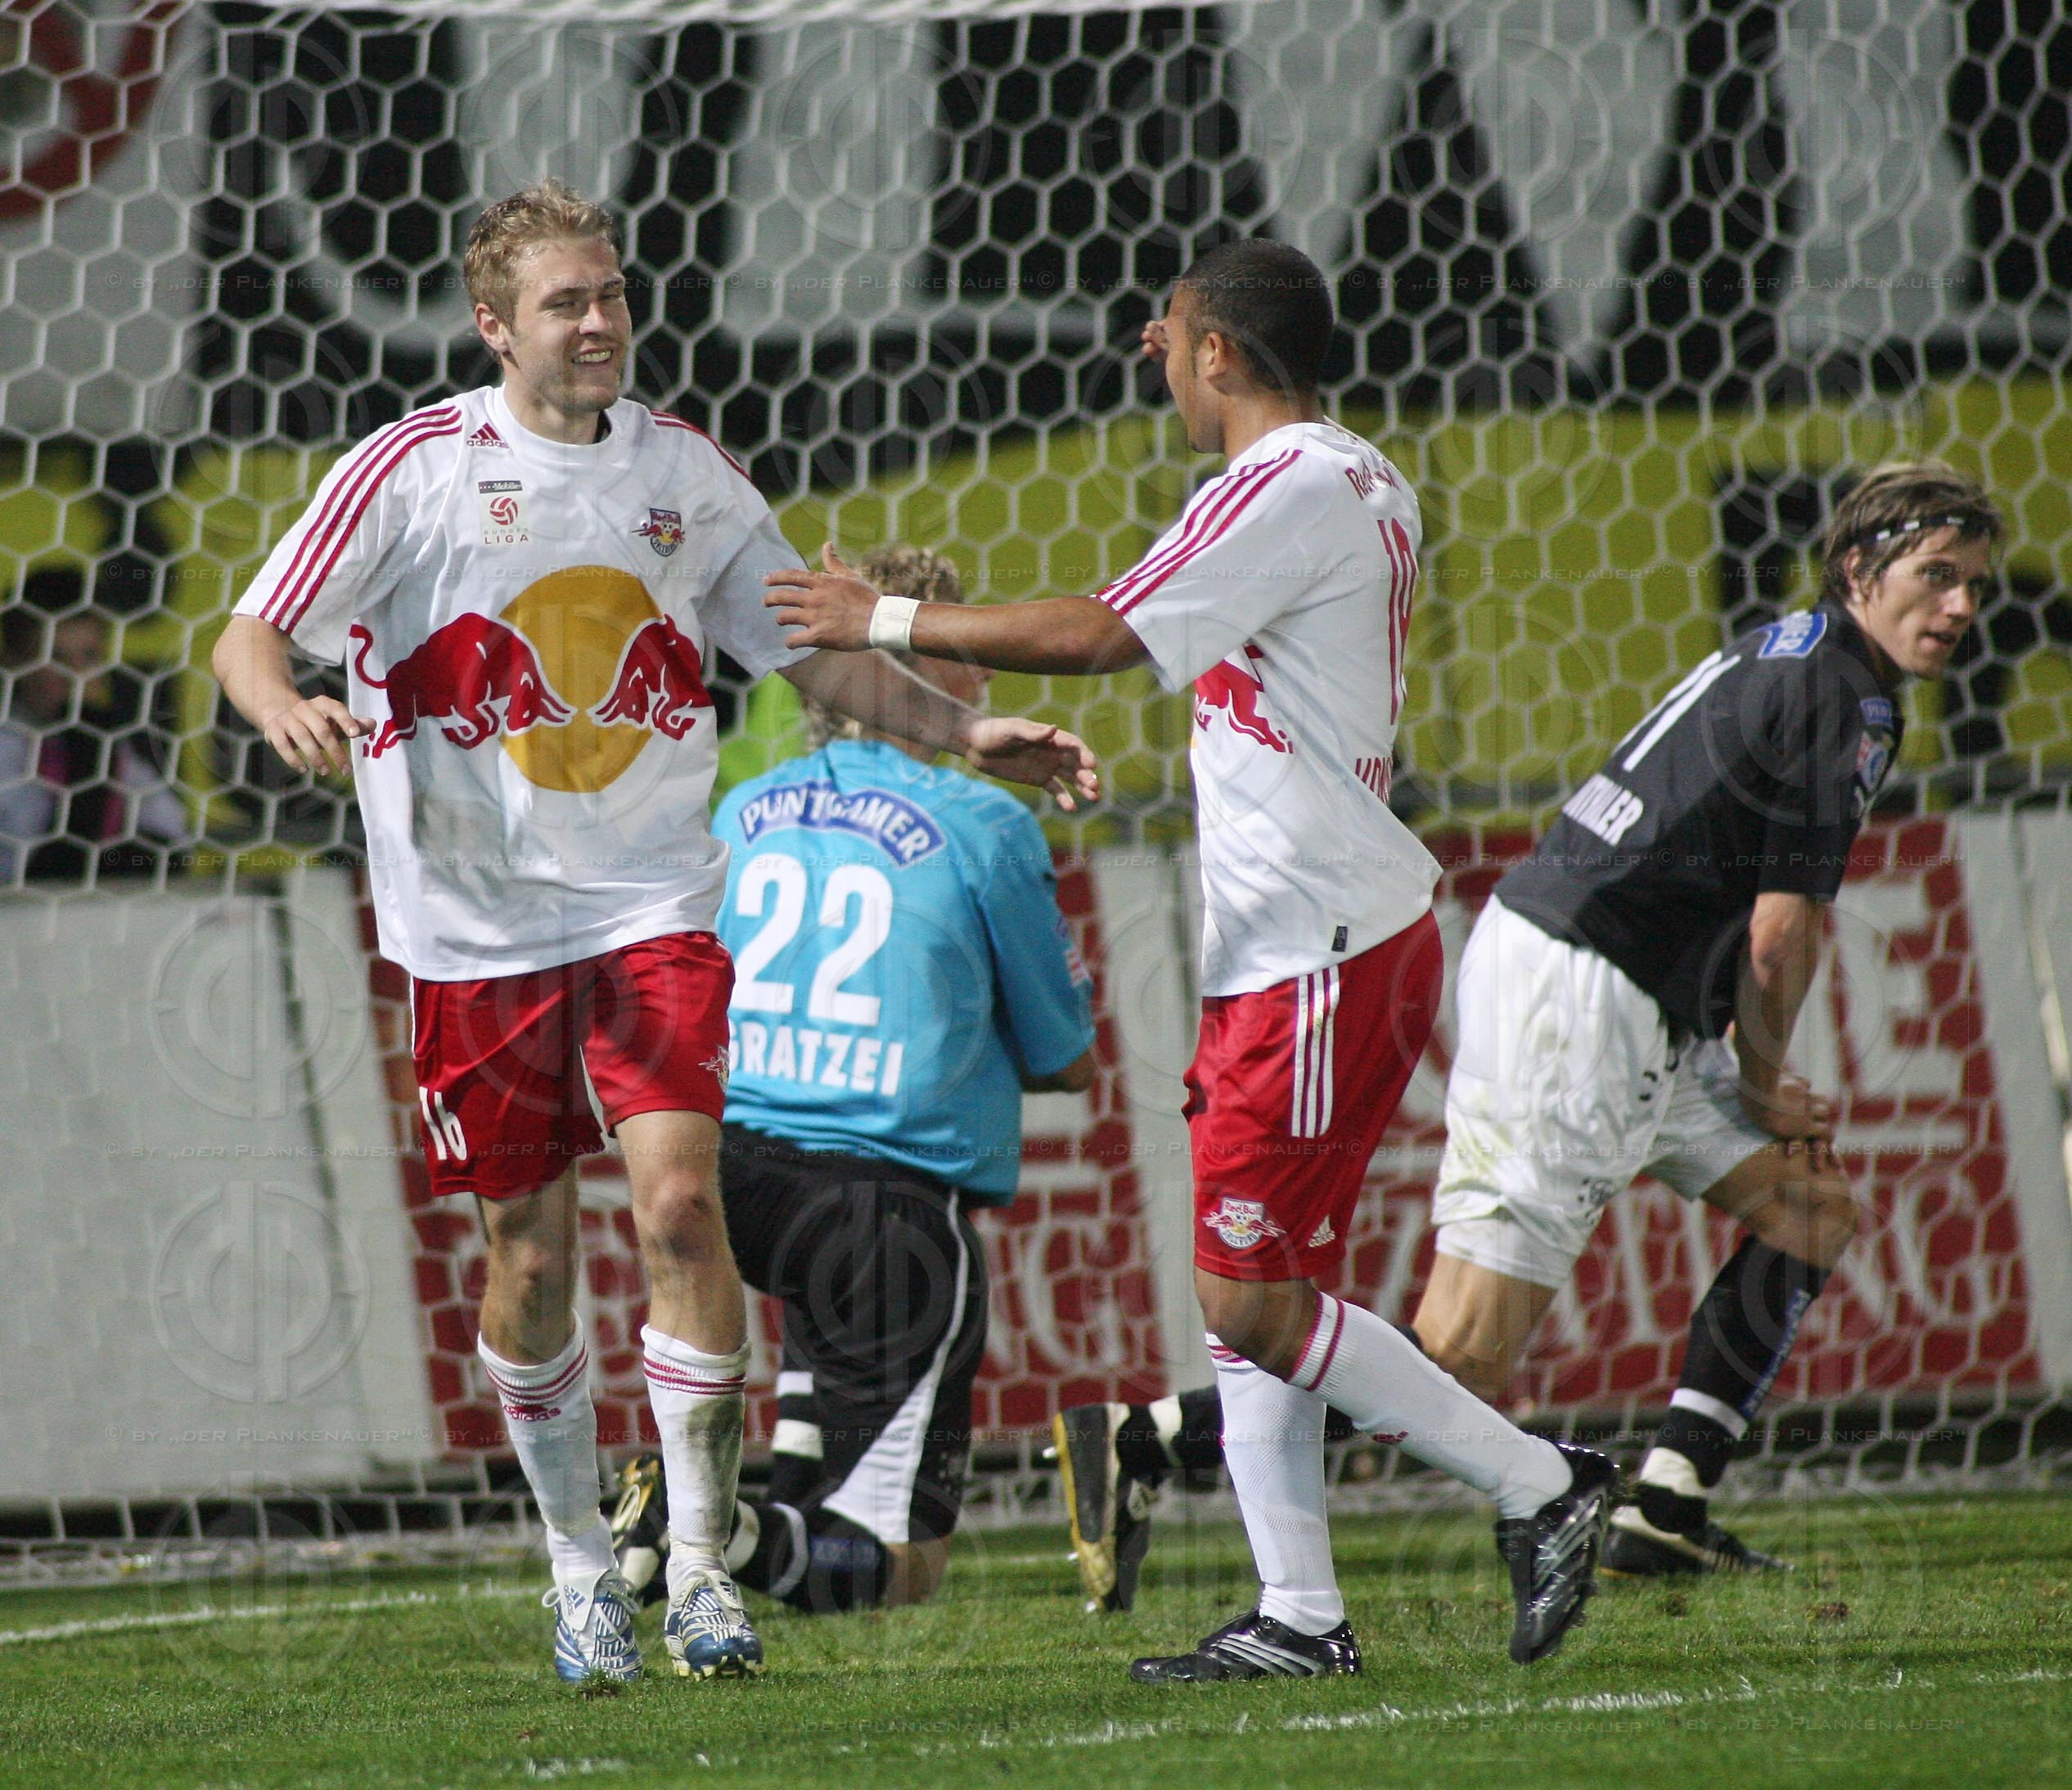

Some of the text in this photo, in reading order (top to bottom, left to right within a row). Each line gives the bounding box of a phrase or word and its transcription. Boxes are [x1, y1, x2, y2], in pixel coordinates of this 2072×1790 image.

[466, 439, 510, 449] adidas
[484, 533, 529, 545] LIGA
[731, 852, 894, 1027] 22
[418, 1086, 467, 1161] 16
